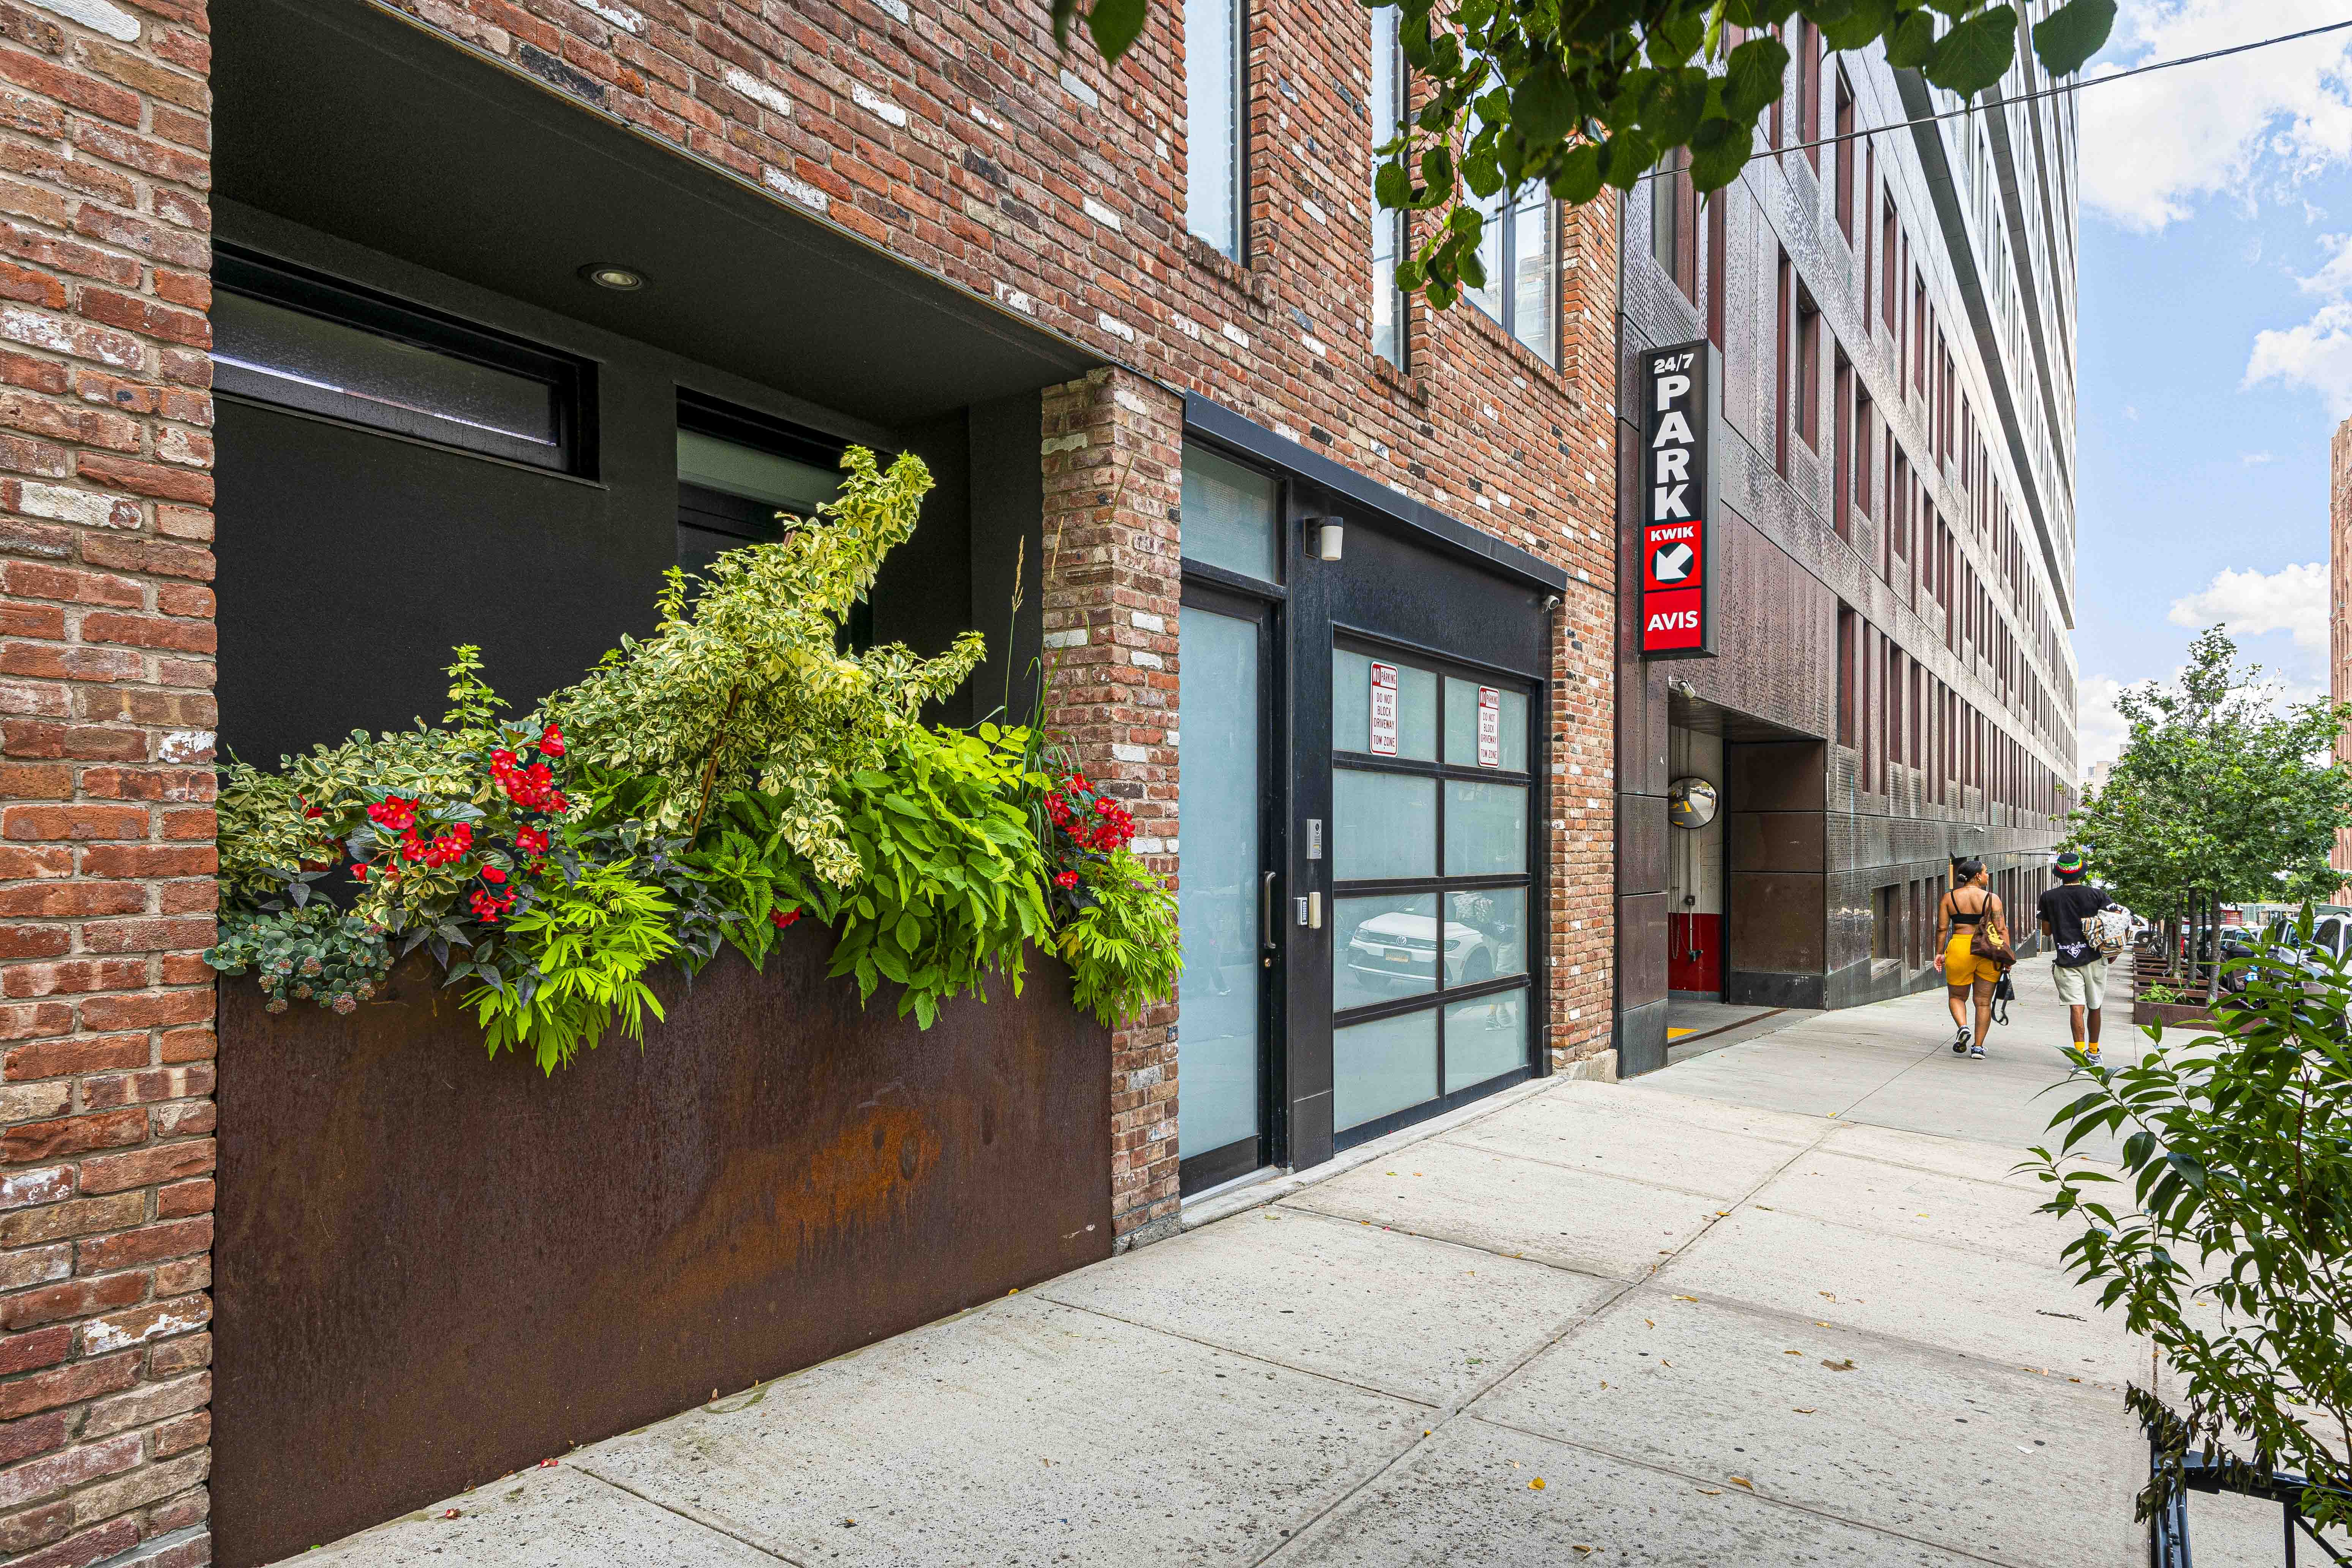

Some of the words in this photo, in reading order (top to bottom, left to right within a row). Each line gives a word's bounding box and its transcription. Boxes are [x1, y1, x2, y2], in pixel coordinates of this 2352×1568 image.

[1654, 353, 1694, 374] 24/7
[1652, 375, 1695, 520] PARK
[1651, 526, 1694, 541] KWIK
[1647, 610, 1698, 631] AVIS
[1373, 668, 1380, 683] NO
[1381, 670, 1396, 684] PARKING
[1377, 692, 1382, 702] DO
[1480, 691, 1486, 704] NO
[1377, 706, 1391, 717] BLOCK
[1483, 712, 1487, 721] DO
[1374, 718, 1394, 729] DRIVEWAY
[1483, 724, 1494, 733] BLOCK
[1374, 735, 1382, 744] TOW
[1384, 736, 1395, 747] ZONE
[1481, 734, 1496, 744] DRIVEWAY
